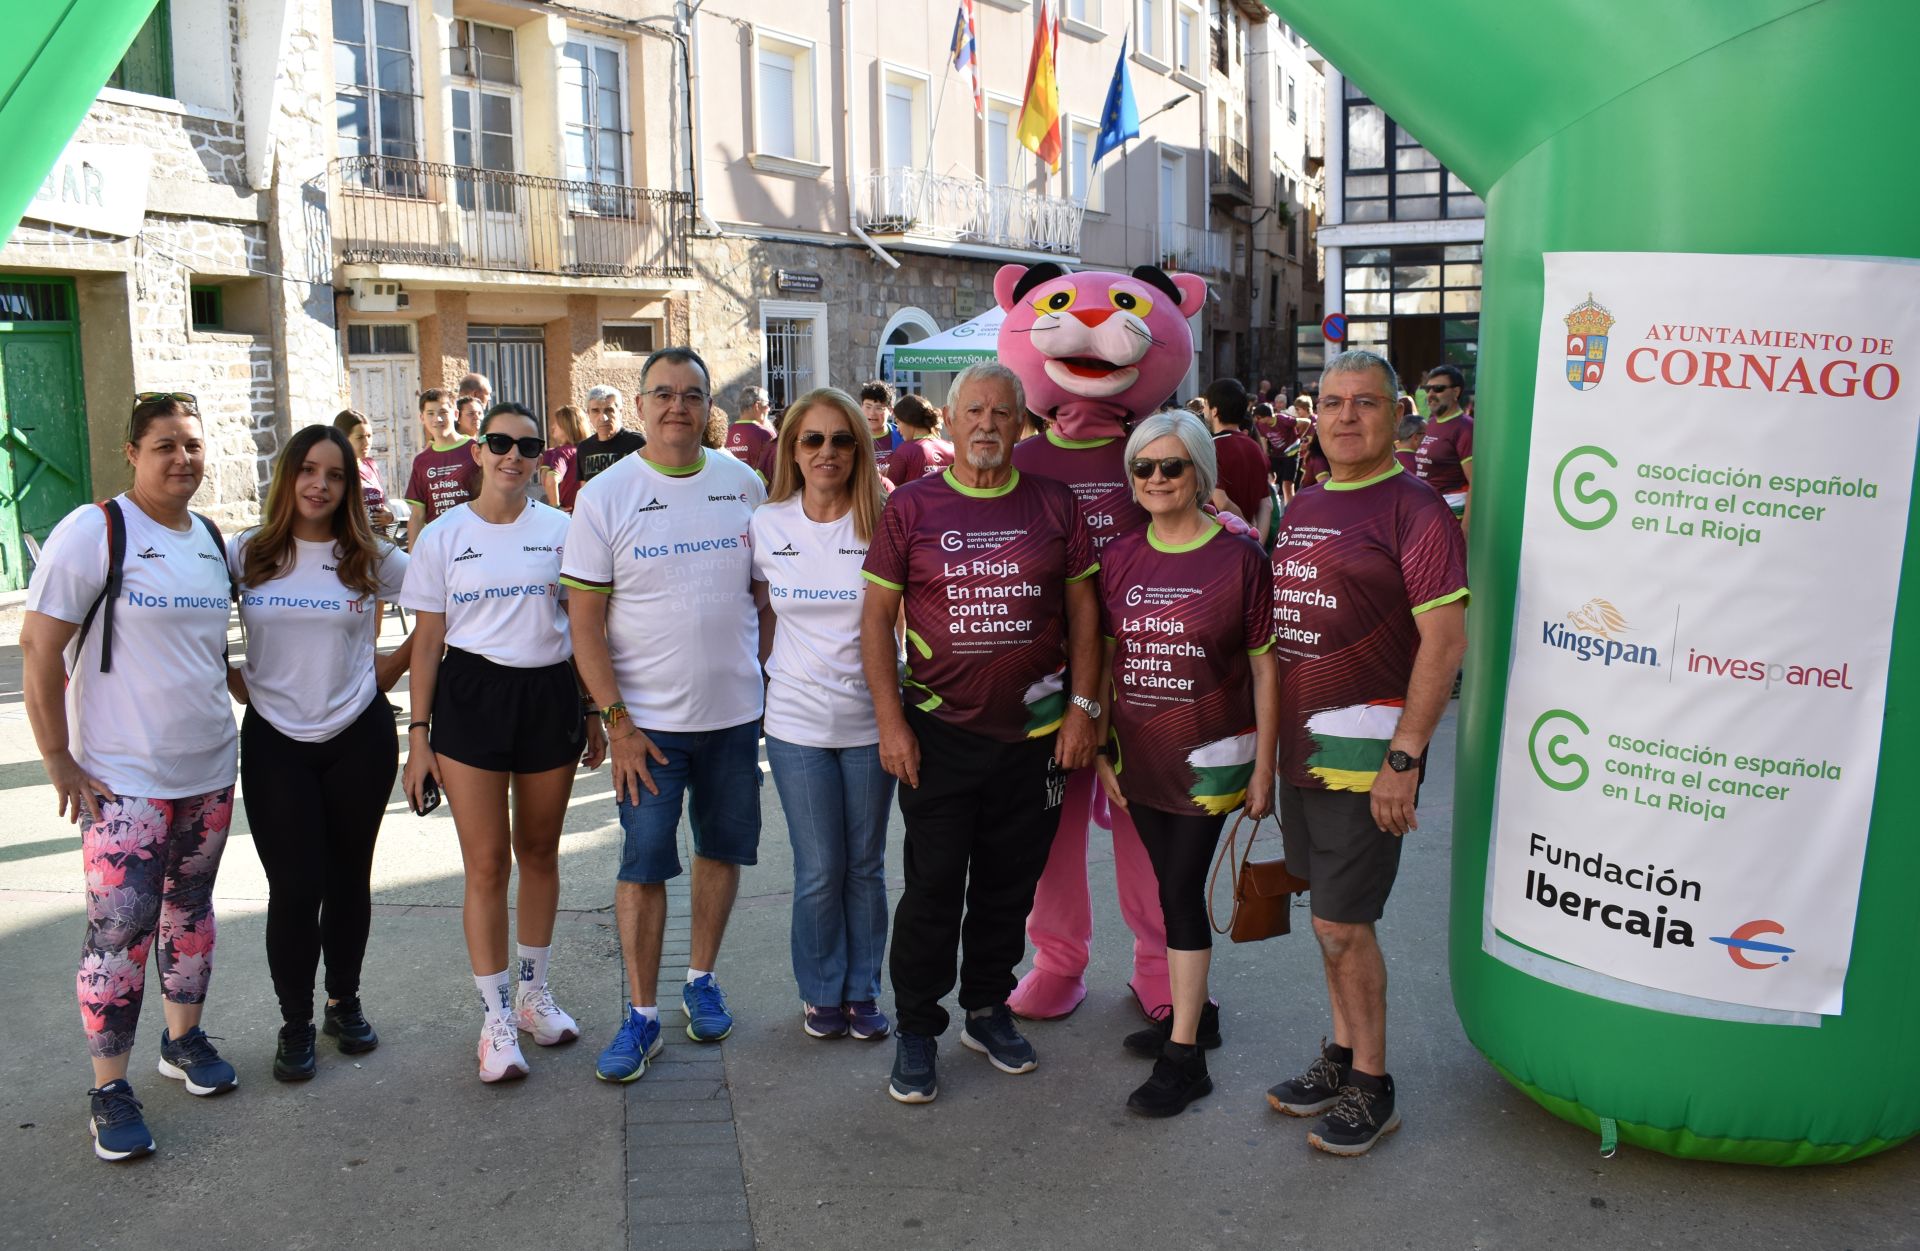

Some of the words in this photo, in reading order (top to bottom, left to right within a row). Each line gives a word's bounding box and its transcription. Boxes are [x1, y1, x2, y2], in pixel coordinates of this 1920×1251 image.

[1645, 324, 1853, 352] AYUNTAMIENTO
[1860, 337, 1894, 356] DE
[899, 354, 947, 365] ASOCIACIÓN
[1625, 347, 1900, 400] CORNAGO
[440, 480, 458, 488] Rioja
[1637, 463, 1761, 489] asociación
[1769, 475, 1878, 498] española
[708, 494, 736, 502] Ibercaja
[1634, 489, 1708, 511] contra
[1715, 494, 1736, 513] el
[1742, 499, 1826, 521] cancer
[1631, 516, 1659, 532] en
[1666, 515, 1694, 536] La
[1701, 519, 1761, 546] Rioja
[634, 545, 669, 560] Nos
[674, 537, 738, 554] mueves
[944, 562, 967, 577] La
[973, 560, 1019, 578] Rioja
[1272, 560, 1283, 576] La
[1286, 560, 1318, 582] Rioja
[128, 591, 168, 608] Nos
[174, 595, 228, 610] mueves
[453, 590, 480, 605] Nos
[485, 584, 546, 598] mueves
[792, 588, 858, 600] mueves
[946, 584, 970, 600] En
[975, 582, 1041, 598] marcha
[1280, 588, 1337, 609] marcha
[268, 596, 341, 611] mueves
[949, 601, 1008, 616] contra
[950, 619, 966, 634] el
[970, 618, 1032, 633] cáncer
[1122, 618, 1140, 632] La
[1146, 618, 1184, 636] Rioja
[1278, 624, 1322, 645] cáncer
[1146, 642, 1206, 658] marcha
[1542, 620, 1657, 667] Kingspan
[1124, 657, 1171, 672] contra
[1687, 648, 1853, 690] invespanel
[1124, 672, 1136, 685] el
[1140, 673, 1194, 690] cáncer
[1608, 733, 1727, 767] asociación
[1734, 755, 1841, 780] española
[1605, 759, 1675, 785] contra
[1681, 771, 1702, 789] el
[1707, 778, 1790, 800] cancer
[1602, 783, 1628, 800] en
[1634, 786, 1661, 808] La
[1668, 793, 1726, 821] Rioja
[1530, 832, 1701, 901] Fundación
[1526, 870, 1694, 949] Ibercaja
